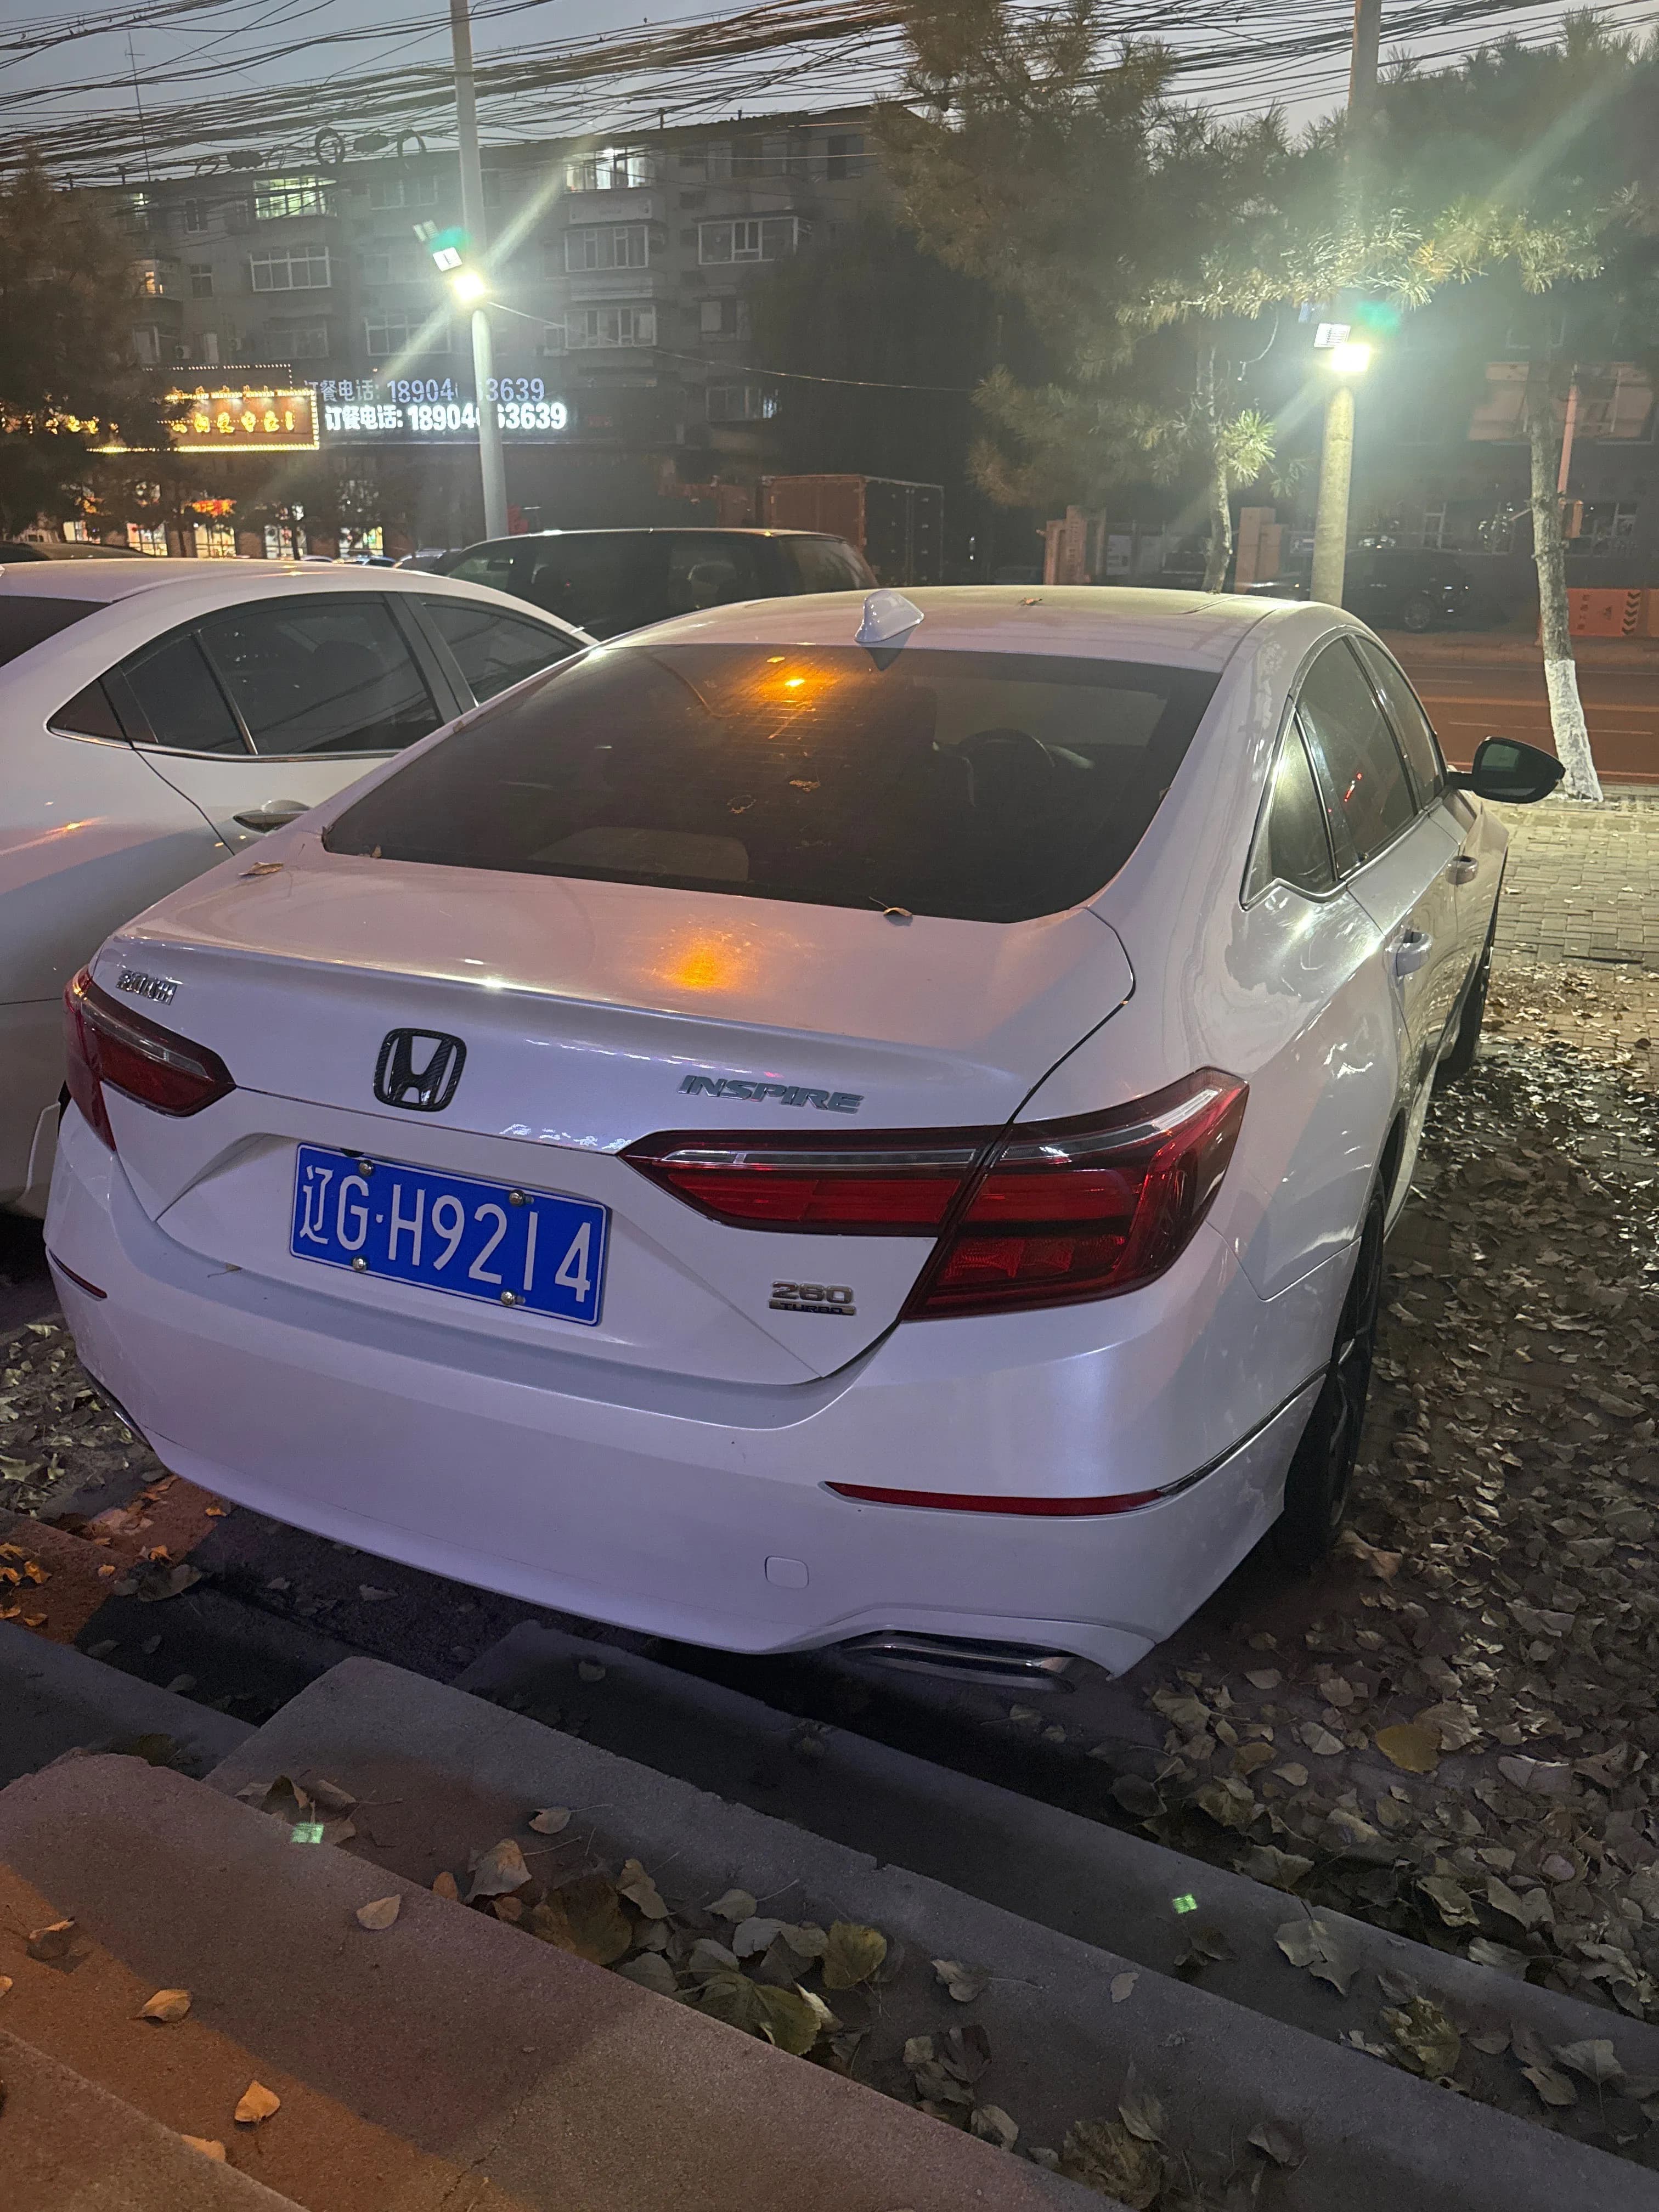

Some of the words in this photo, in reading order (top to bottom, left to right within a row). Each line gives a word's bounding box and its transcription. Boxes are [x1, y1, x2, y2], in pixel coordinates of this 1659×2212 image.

[387, 378, 545, 403] 189043639
[408, 402, 567, 431] 189043639
[677, 1075, 864, 1114] INSPIRE
[300, 1165, 591, 1303] 辽G·H9214
[780, 1302, 843, 1314] TURBO
